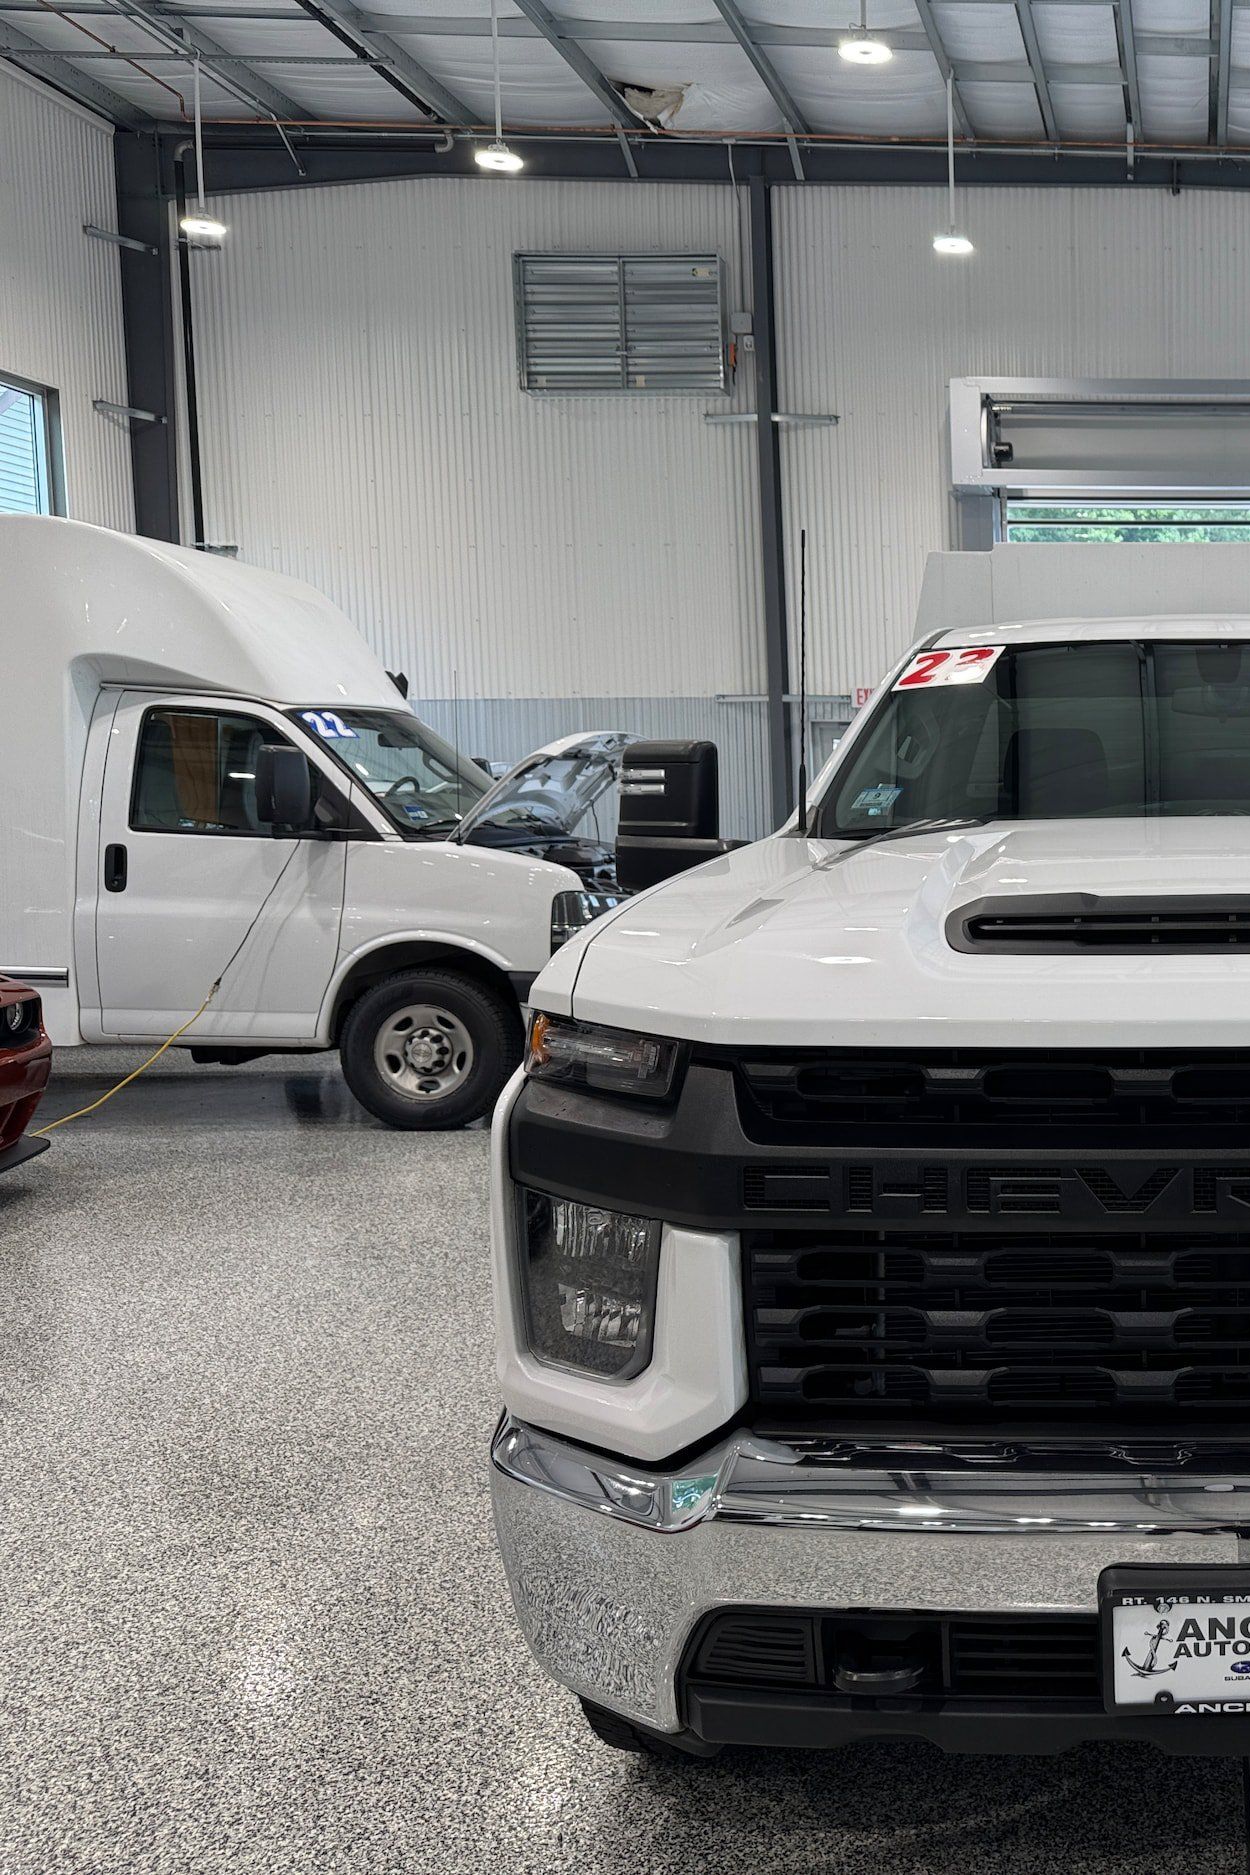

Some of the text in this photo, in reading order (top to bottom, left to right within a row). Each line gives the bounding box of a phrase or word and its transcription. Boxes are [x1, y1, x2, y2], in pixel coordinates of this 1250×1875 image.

[301, 711, 358, 738] 22
[1121, 1597, 1148, 1605] RT.
[1155, 1596, 1190, 1604] 146
[1196, 1595, 1216, 1604] N.
[1173, 1640, 1250, 1659] AUTO
